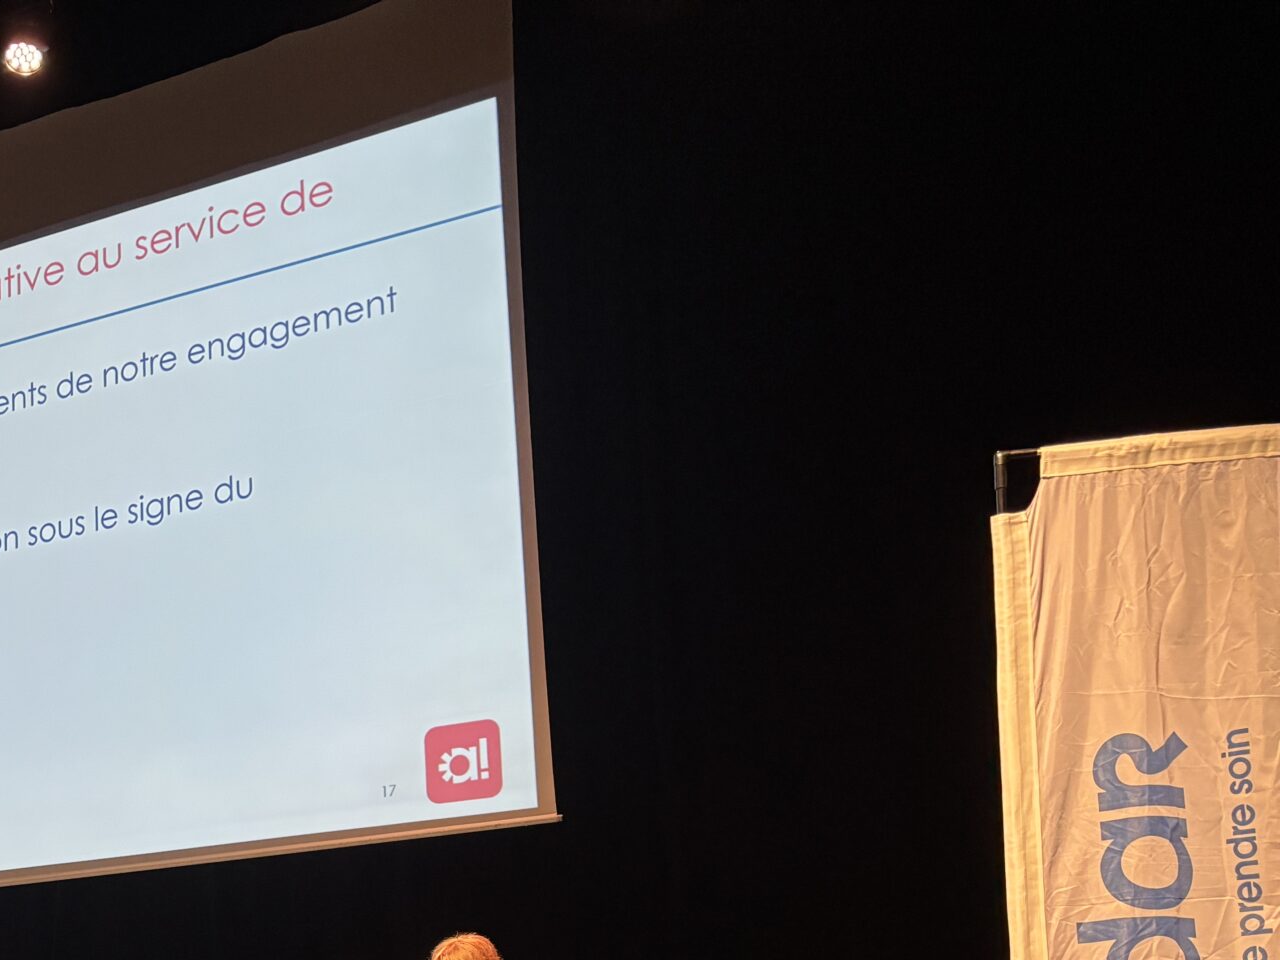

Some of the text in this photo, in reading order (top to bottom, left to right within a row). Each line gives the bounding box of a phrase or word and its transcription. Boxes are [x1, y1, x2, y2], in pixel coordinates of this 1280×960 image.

[77, 243, 122, 276] au
[135, 201, 266, 260] service
[280, 180, 333, 216] de
[56, 371, 93, 399] de
[103, 351, 177, 387] notre
[188, 286, 398, 364] engagement
[28, 515, 86, 546] sous
[94, 506, 119, 531] le
[127, 489, 204, 526] signe
[214, 475, 254, 504] du
[381, 784, 397, 798] 17
[1220, 727, 1254, 795] soin
[1225, 803, 1273, 938] prendre
